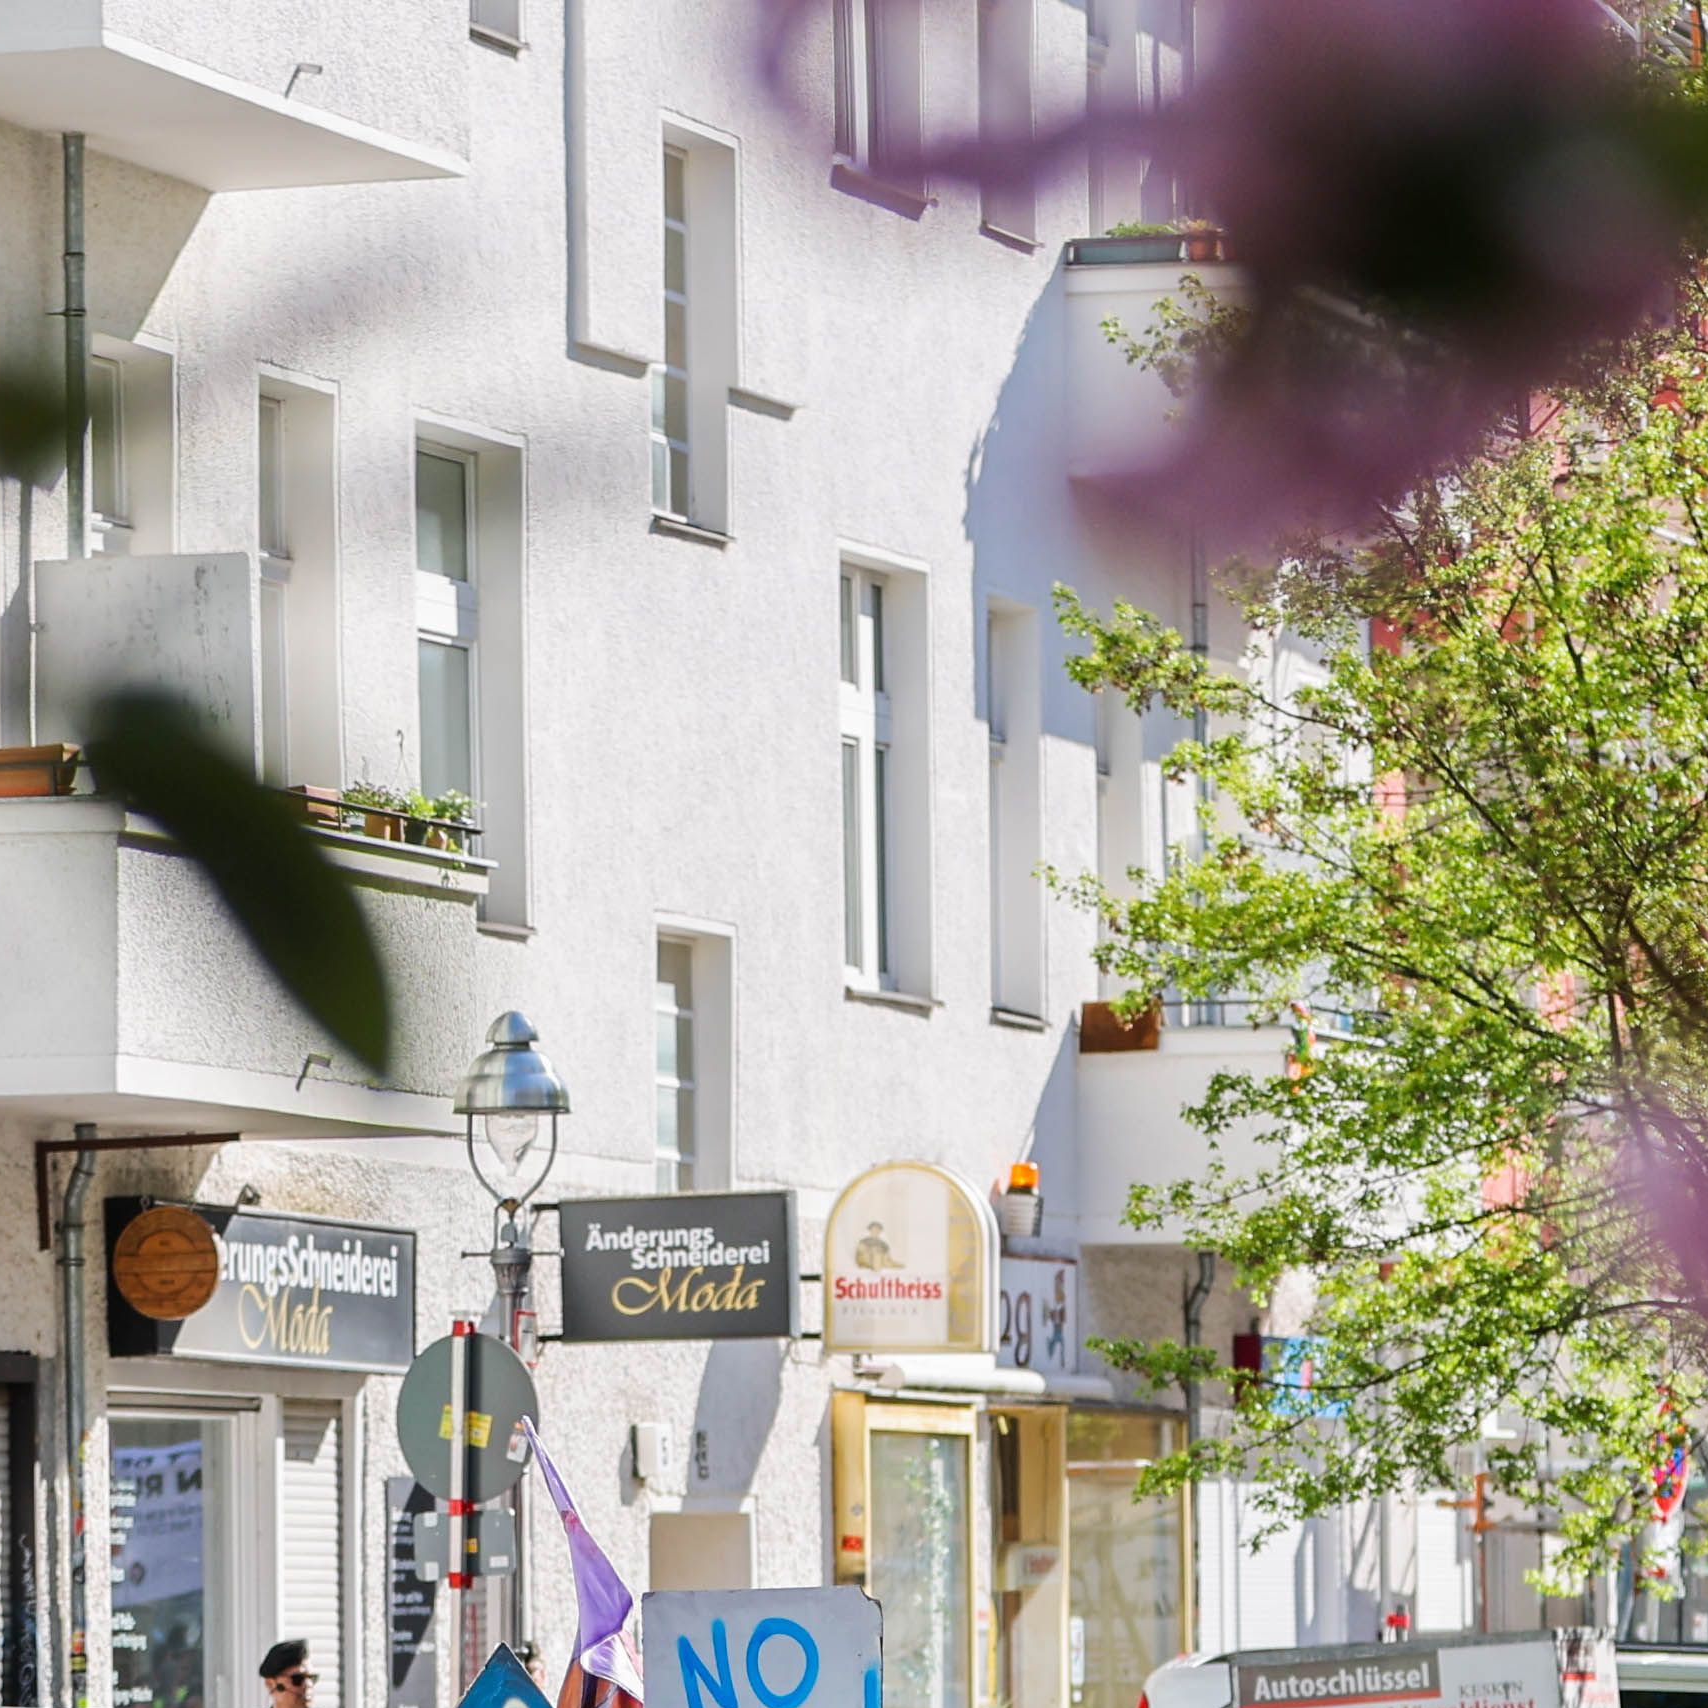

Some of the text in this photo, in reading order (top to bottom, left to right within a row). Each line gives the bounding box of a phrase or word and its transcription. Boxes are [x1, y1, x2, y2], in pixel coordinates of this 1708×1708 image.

[585, 1223, 715, 1251] Änderungs
[630, 1240, 770, 1270] Schneiderei
[213, 1232, 399, 1298] erungsSchneiderei
[611, 1265, 766, 1316] Moda
[835, 1276, 942, 1300] Schultheiss
[238, 1277, 334, 1355] Moda
[1254, 1661, 1430, 1701] Autoschlüssel
